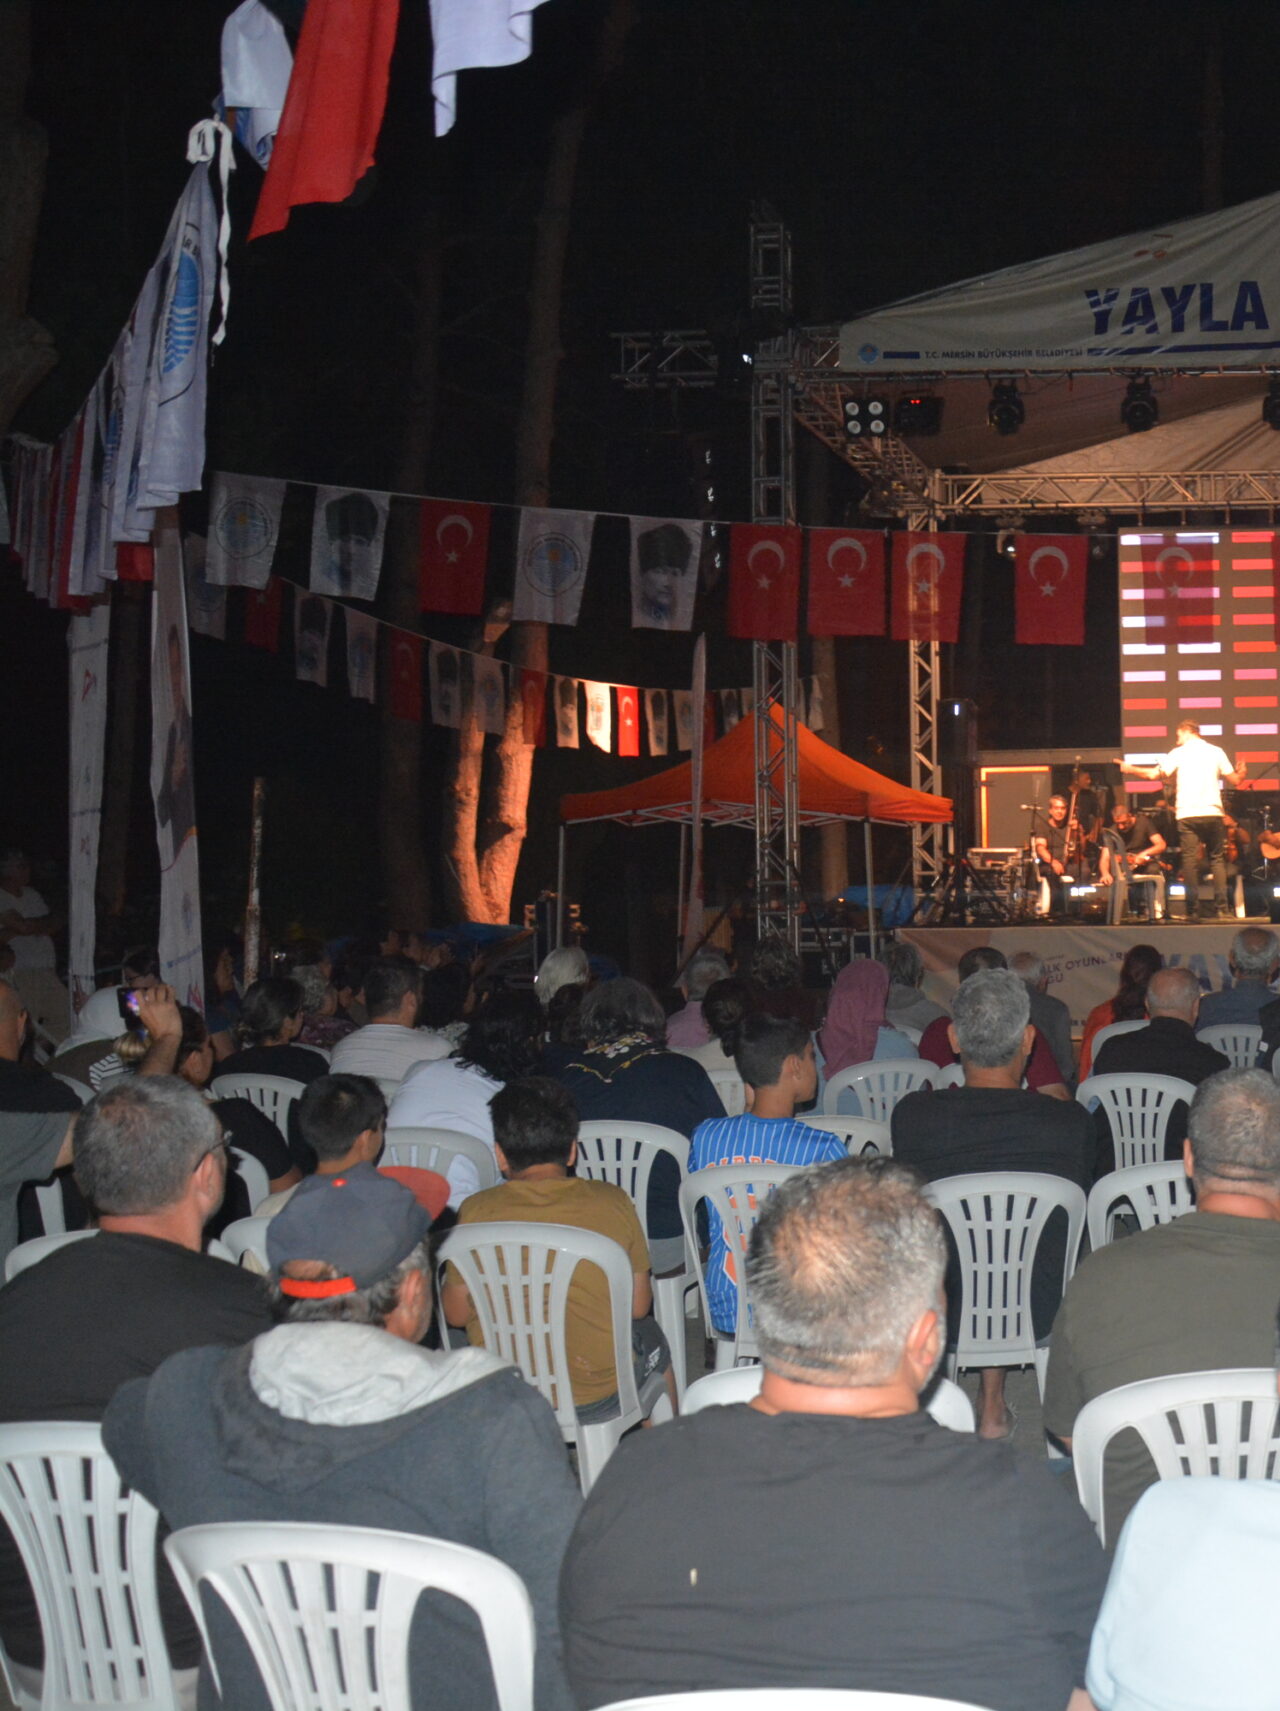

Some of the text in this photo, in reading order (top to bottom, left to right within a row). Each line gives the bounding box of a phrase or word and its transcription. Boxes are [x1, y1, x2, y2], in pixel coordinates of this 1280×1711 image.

[1085, 281, 1270, 335] YAYLA
[925, 351, 940, 359] T.C.
[942, 350, 975, 359] MERSİN
[977, 348, 1033, 360] BÜYÜKŞEHİR
